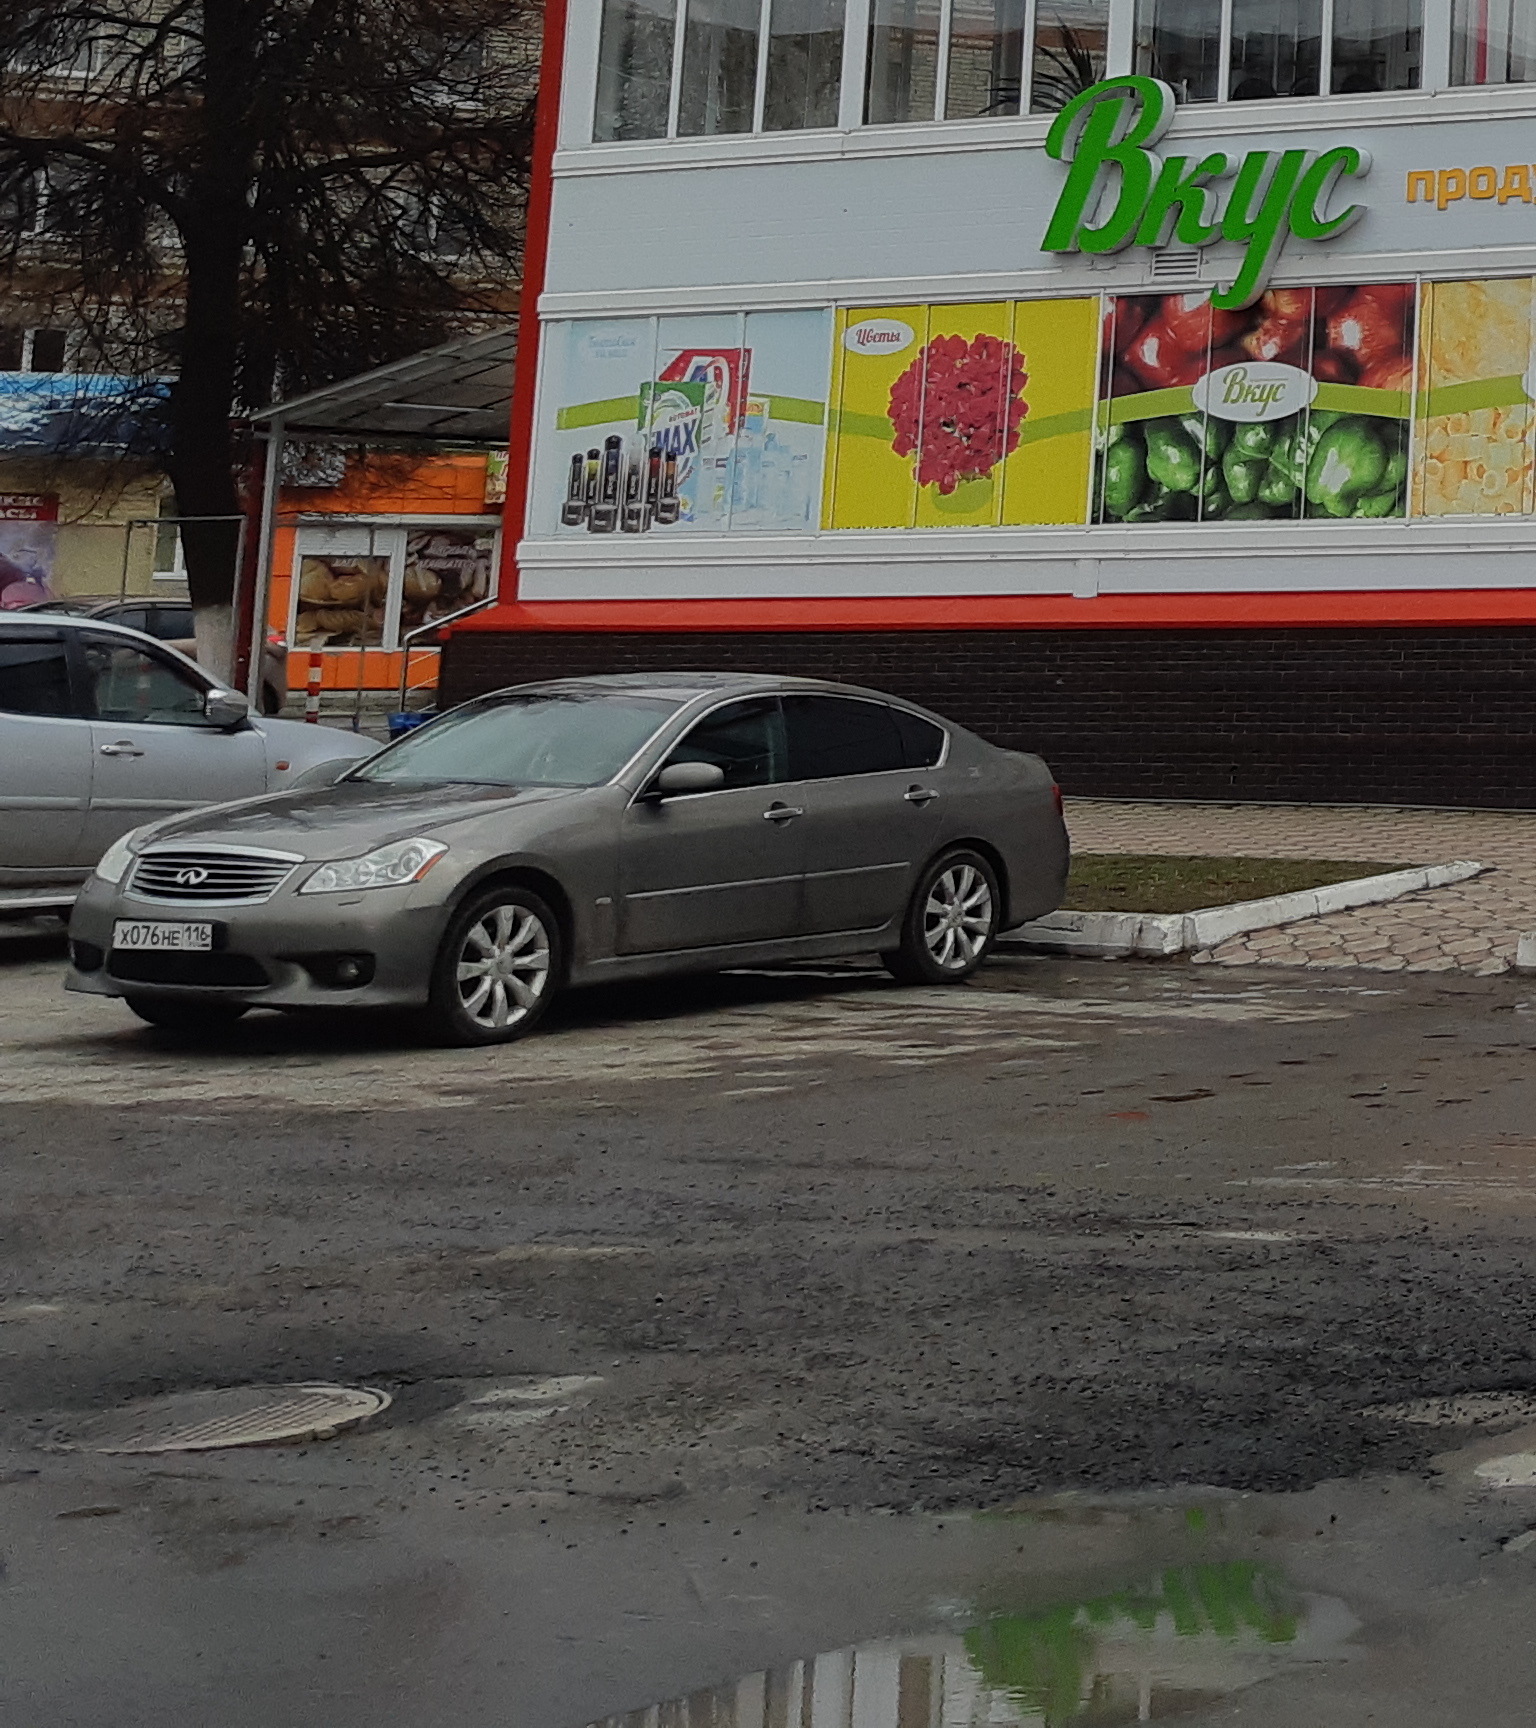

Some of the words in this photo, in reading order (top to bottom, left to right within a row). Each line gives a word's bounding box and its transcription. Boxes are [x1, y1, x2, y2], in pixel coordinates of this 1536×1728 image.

[1040, 74, 1374, 311] Вкус
[855, 328, 902, 347] Цветы
[1222, 366, 1287, 417] Вкус
